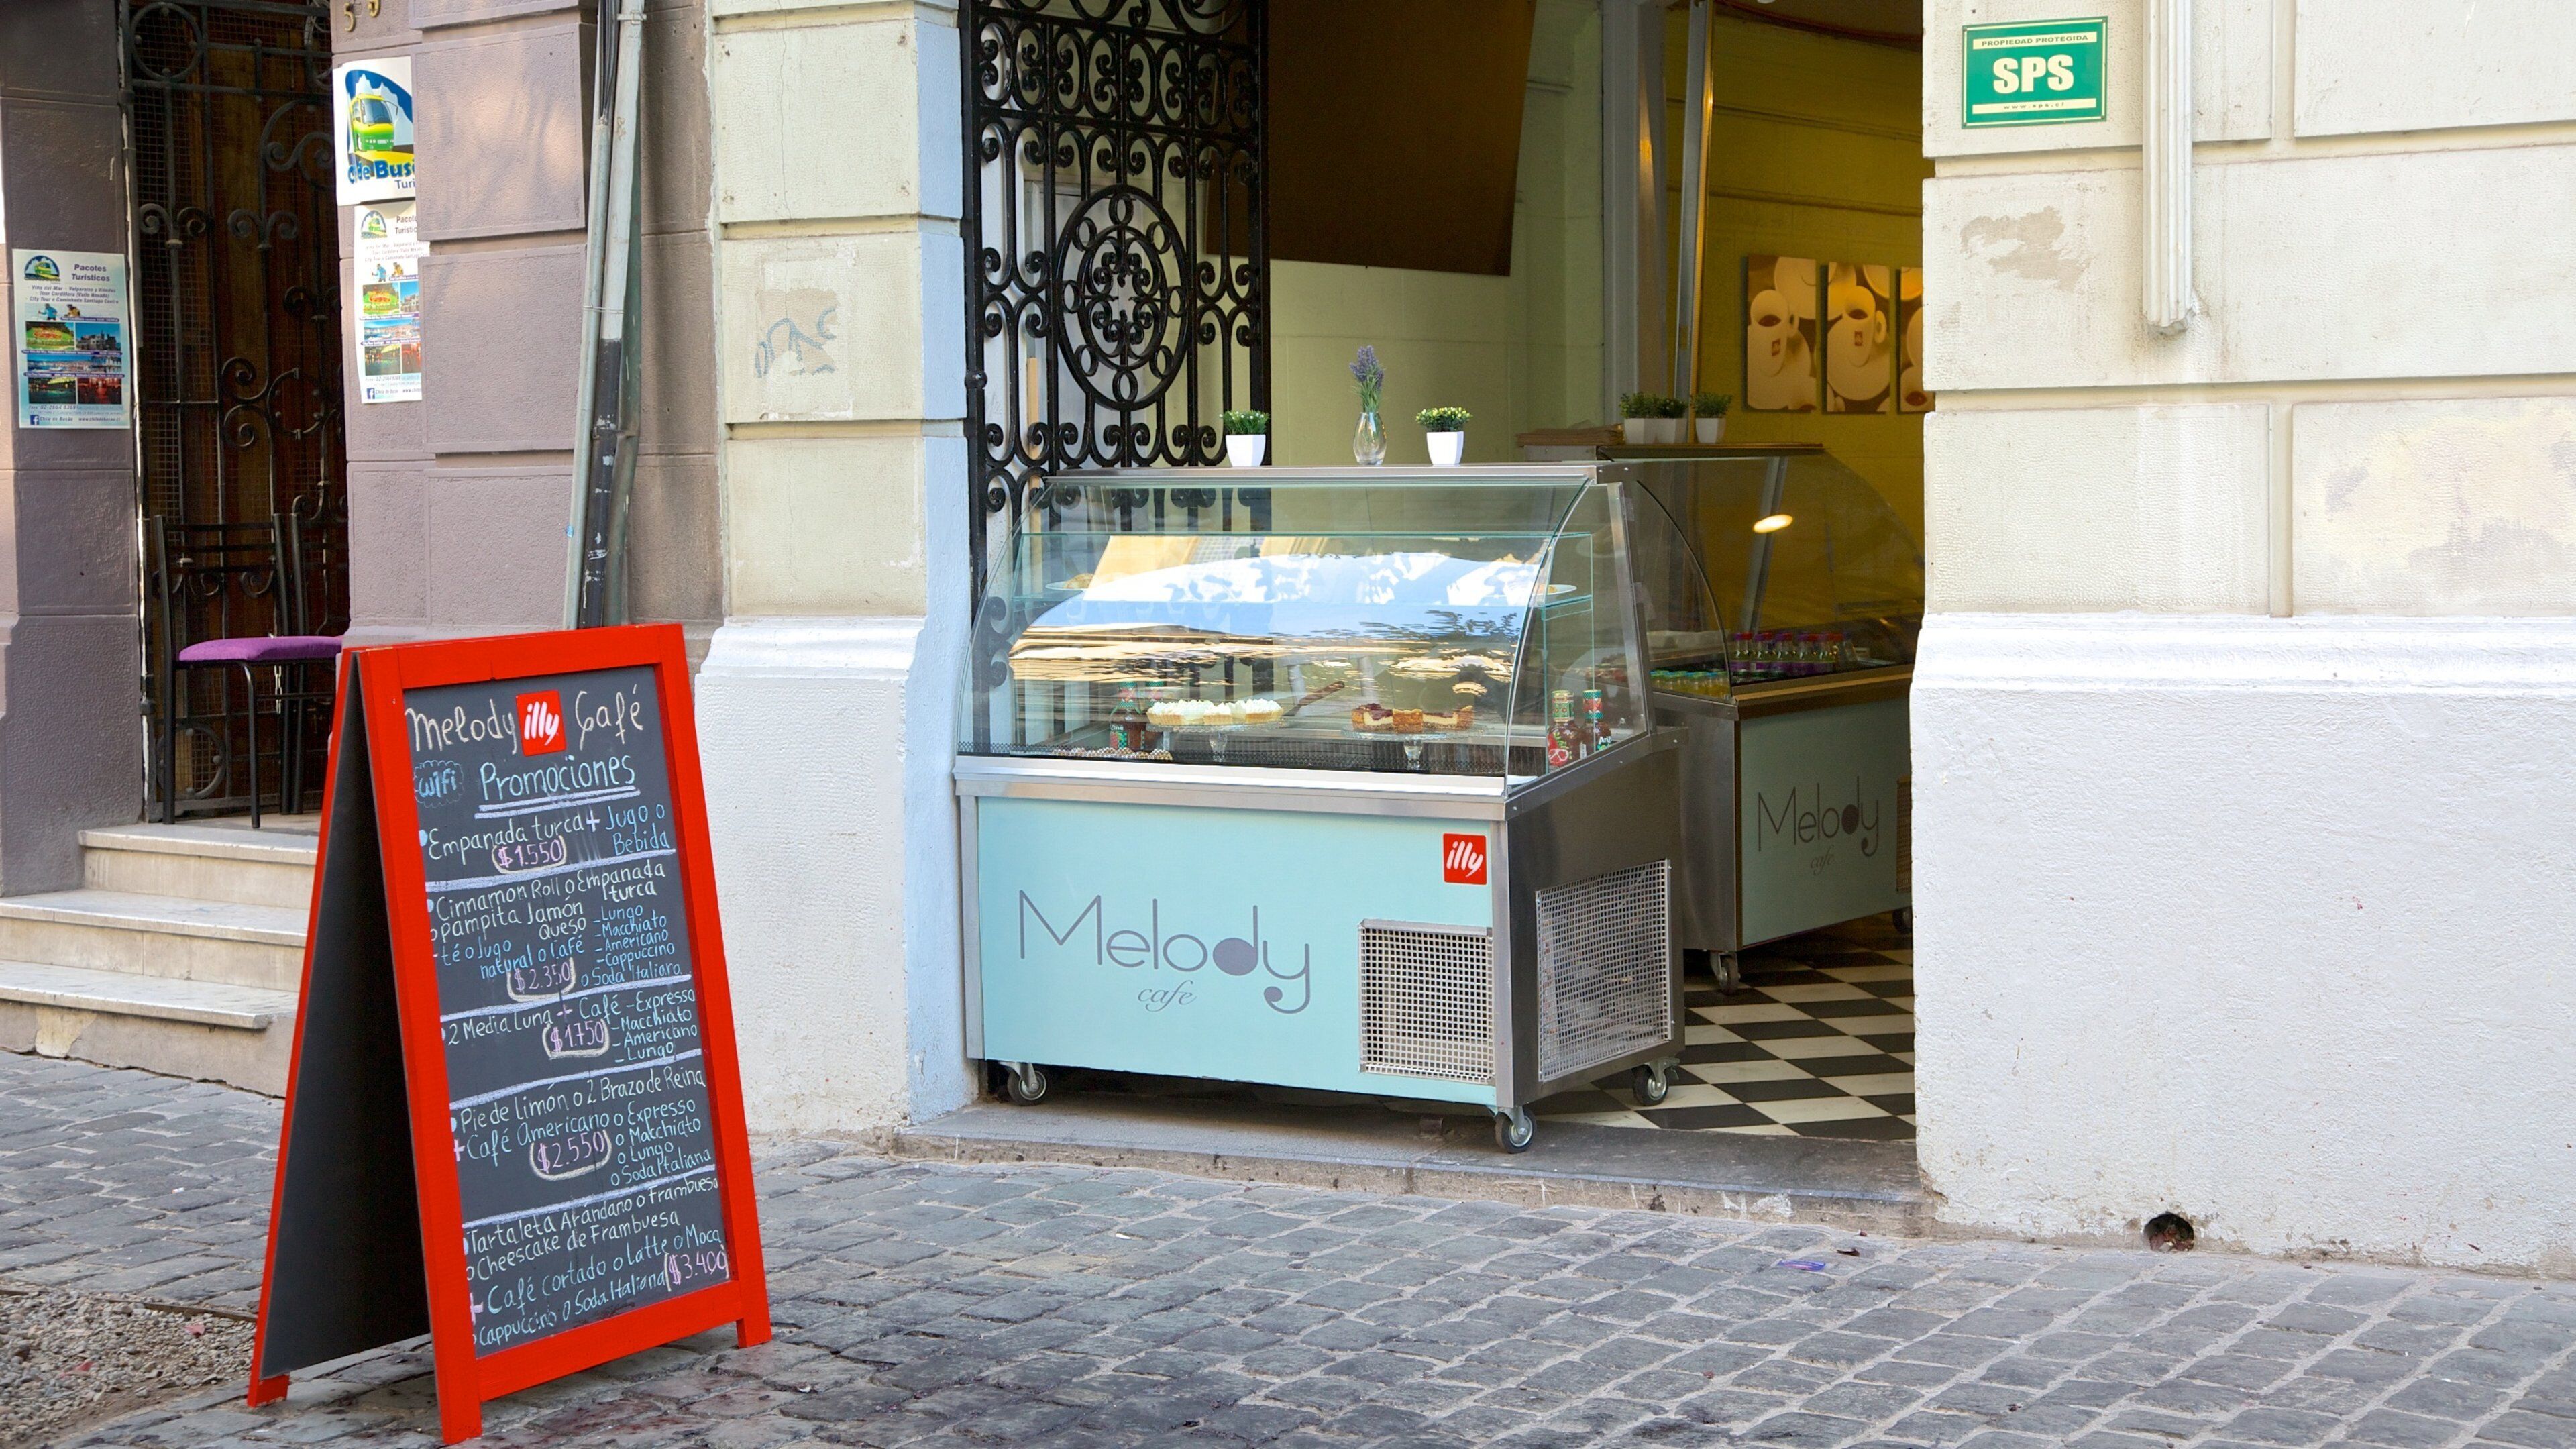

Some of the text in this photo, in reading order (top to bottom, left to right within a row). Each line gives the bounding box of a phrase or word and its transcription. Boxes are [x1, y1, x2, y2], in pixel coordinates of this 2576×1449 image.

[1981, 34, 2088, 46] PROPIEDAD PROTEGIDA
[1992, 54, 2074, 94] SPS
[74, 263, 107, 272] Pacotes
[405, 698, 517, 755] Melody
[523, 700, 561, 746] illy
[479, 754, 637, 801] Promociones
[1757, 775, 1879, 857] Melody
[428, 817, 529, 865] Empanada
[612, 826, 671, 857] Bebida
[1446, 840, 1484, 878] illy
[436, 885, 528, 922] Cinnamon
[531, 877, 561, 899] Roll
[576, 859, 666, 900] Empanada
[1018, 889, 1311, 1014] Melody
[592, 966, 625, 985] Soda
[1136, 979, 1198, 1013] cafe
[462, 1014, 513, 1040] Media
[578, 993, 622, 1025] Café
[489, 1101, 510, 1125] de
[600, 1076, 645, 1102] Brazo
[645, 1067, 662, 1093] de
[663, 1065, 706, 1090] Reina
[466, 1127, 513, 1168] Café
[627, 1099, 696, 1131] Expresso
[629, 1141, 674, 1163] Lungo
[621, 1162, 657, 1185] Soda
[647, 1176, 719, 1205] Frambuesa
[566, 1230, 588, 1252] de
[590, 1210, 681, 1244] Frambuesa
[487, 1275, 537, 1316] Café
